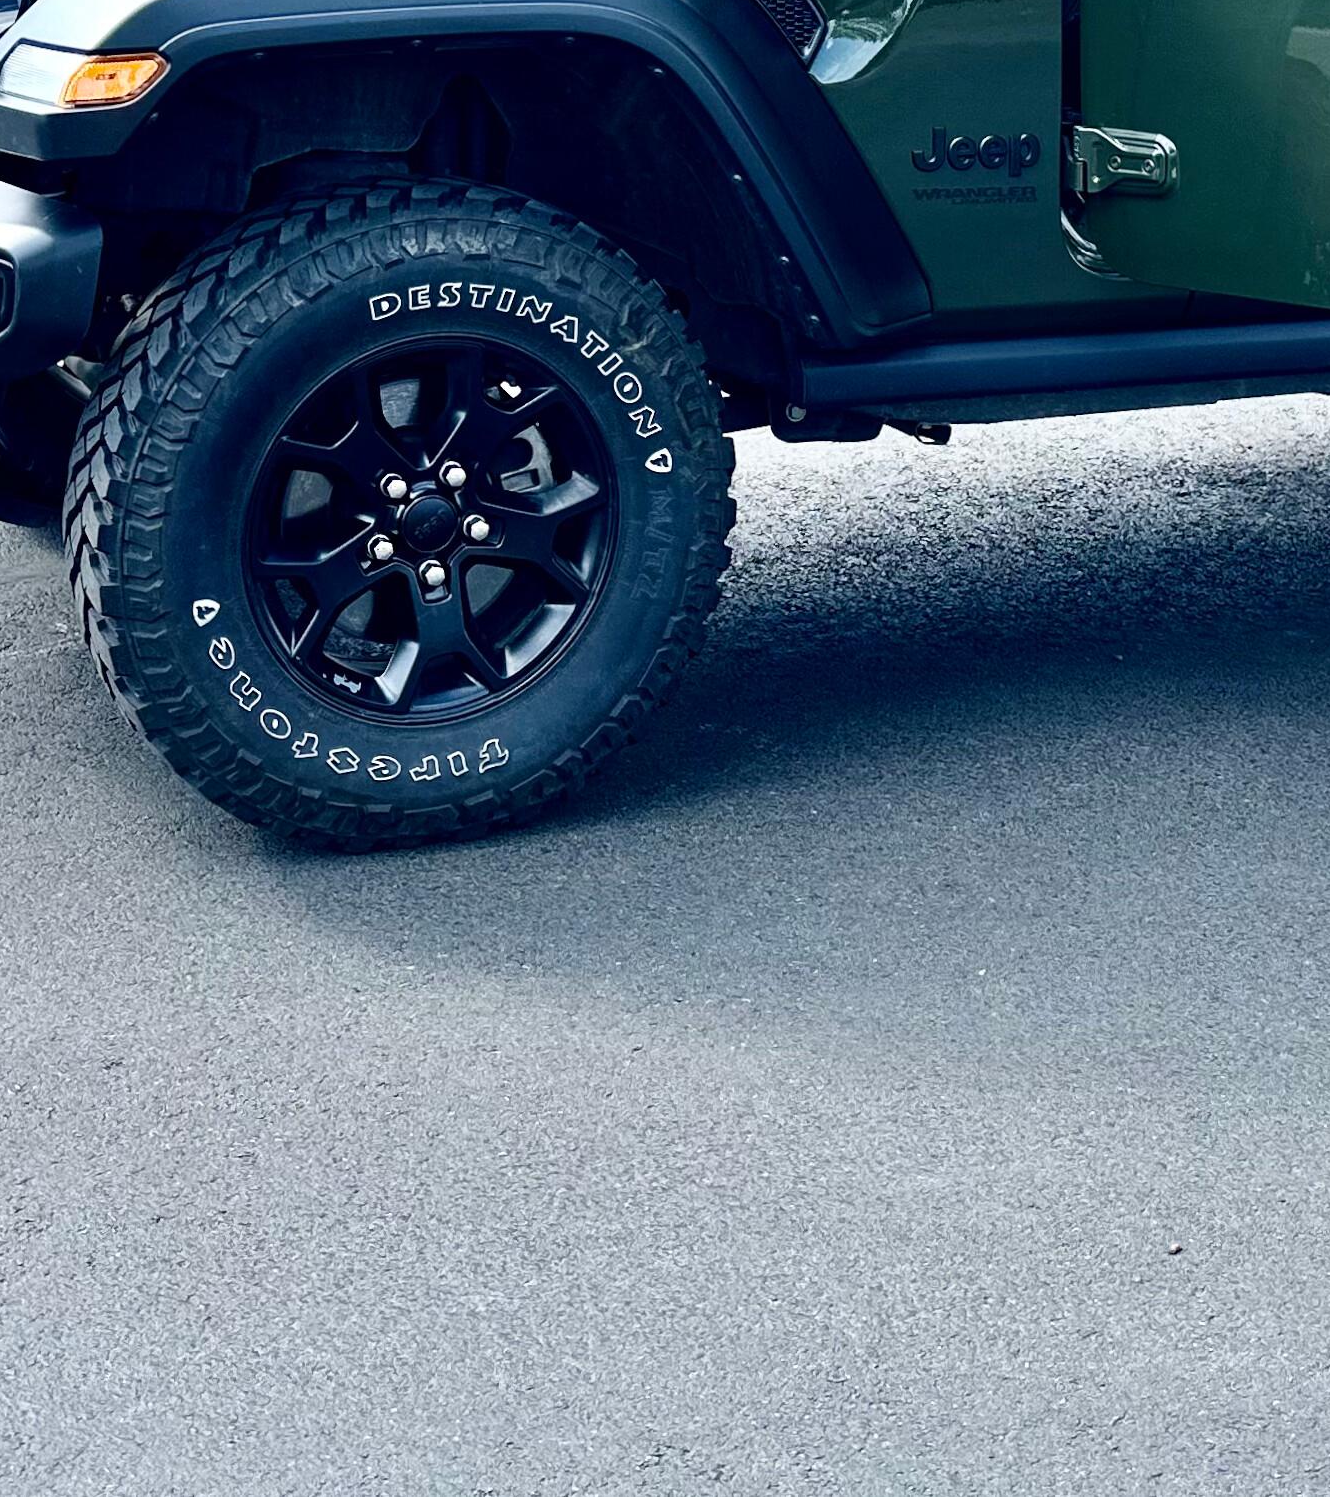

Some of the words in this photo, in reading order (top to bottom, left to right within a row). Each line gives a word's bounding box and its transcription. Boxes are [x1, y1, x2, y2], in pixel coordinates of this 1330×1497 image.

[911, 126, 1041, 177] Jeep
[912, 186, 1037, 201] WRANGLER
[369, 282, 662, 438] DESTINATION
[209, 637, 509, 781] Firestone
